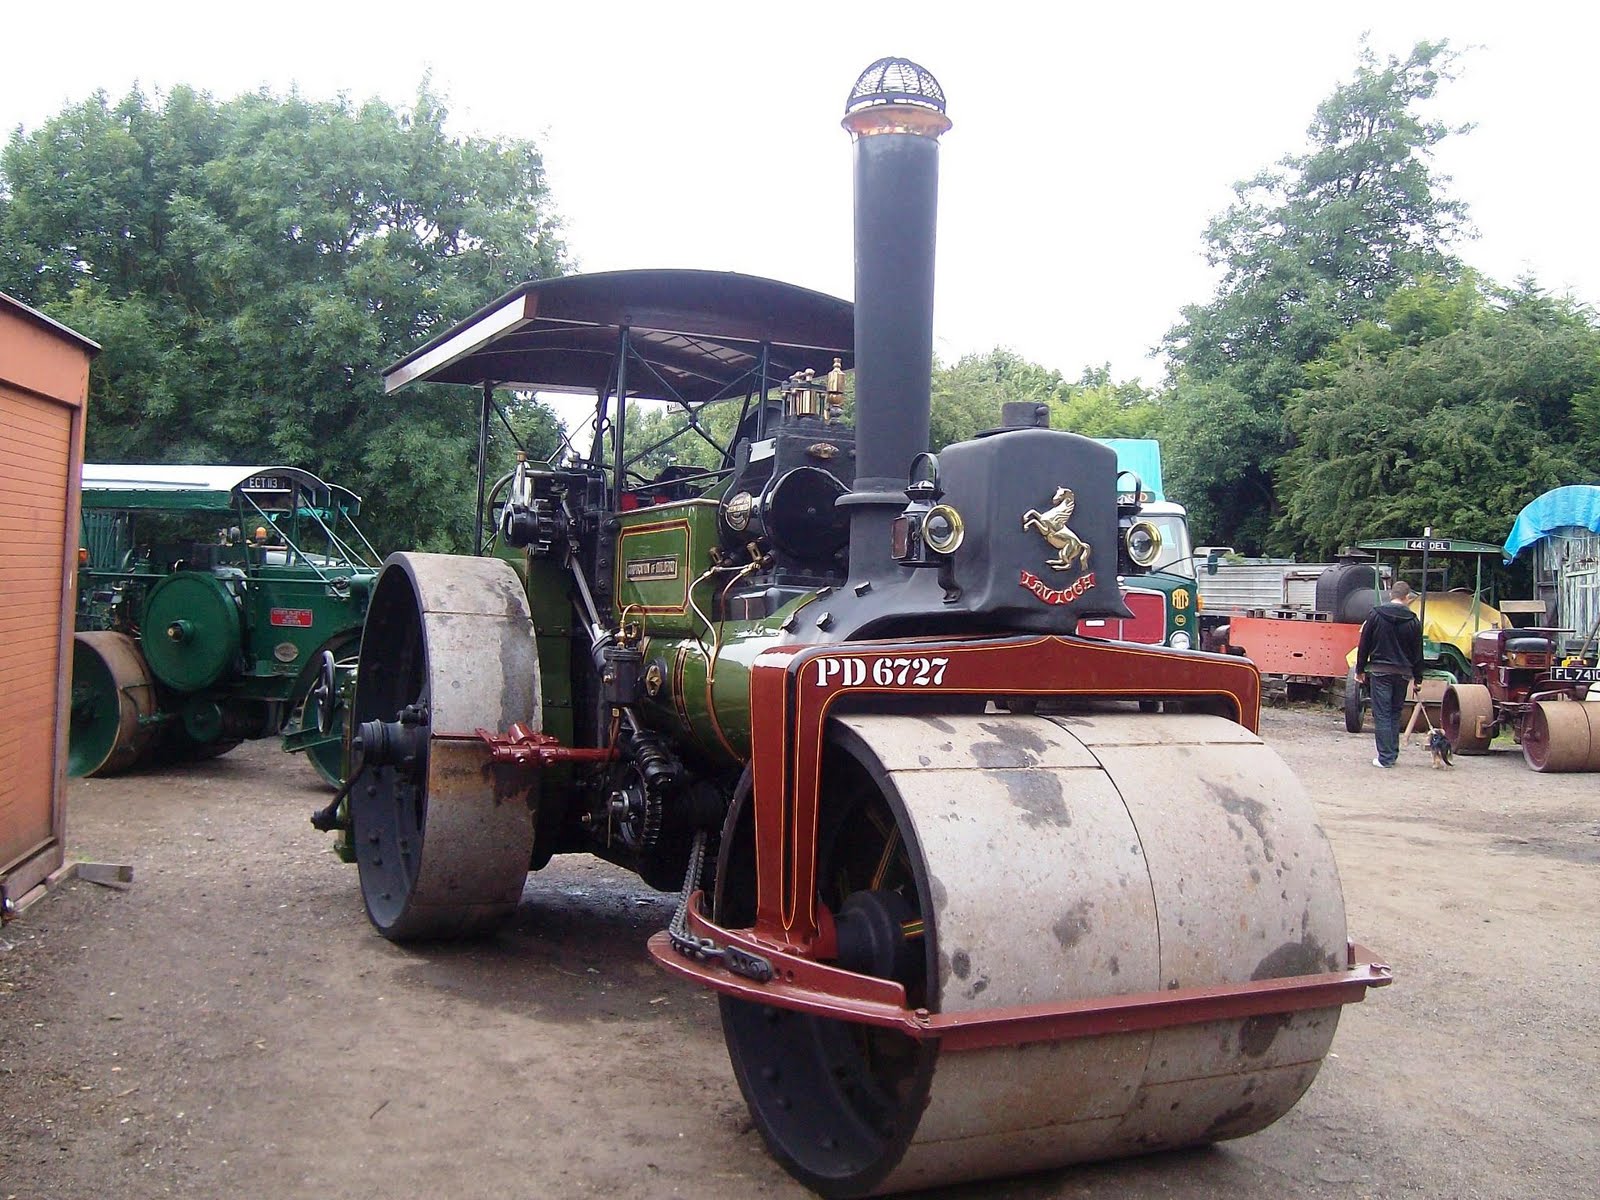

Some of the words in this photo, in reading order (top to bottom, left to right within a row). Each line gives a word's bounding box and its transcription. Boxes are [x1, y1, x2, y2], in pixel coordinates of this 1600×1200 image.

[249, 477, 266, 488] ECT
[1429, 541, 1447, 550] DEL
[815, 658, 867, 686] PD
[872, 657, 949, 686] 6727
[1555, 668, 1573, 680] FL
